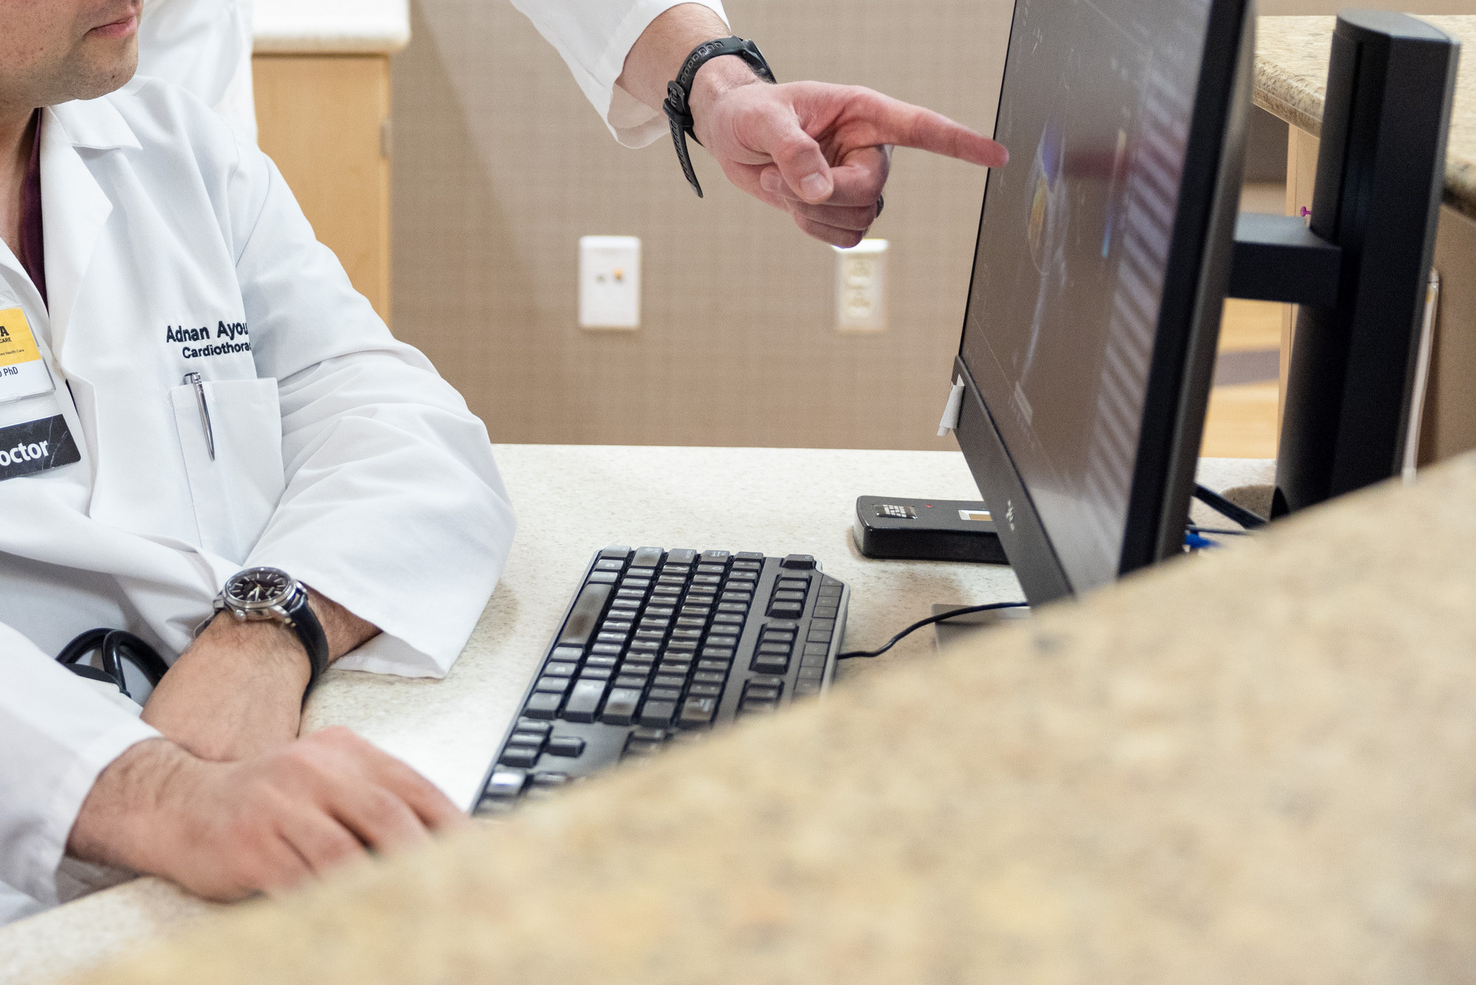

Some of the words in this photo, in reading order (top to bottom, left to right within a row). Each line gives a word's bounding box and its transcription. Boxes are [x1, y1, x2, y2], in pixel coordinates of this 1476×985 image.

[166, 325, 211, 343] Adnan
[216, 320, 249, 341] Ayou
[182, 341, 252, 359] Cardiothora
[4, 366, 19, 376] PhD
